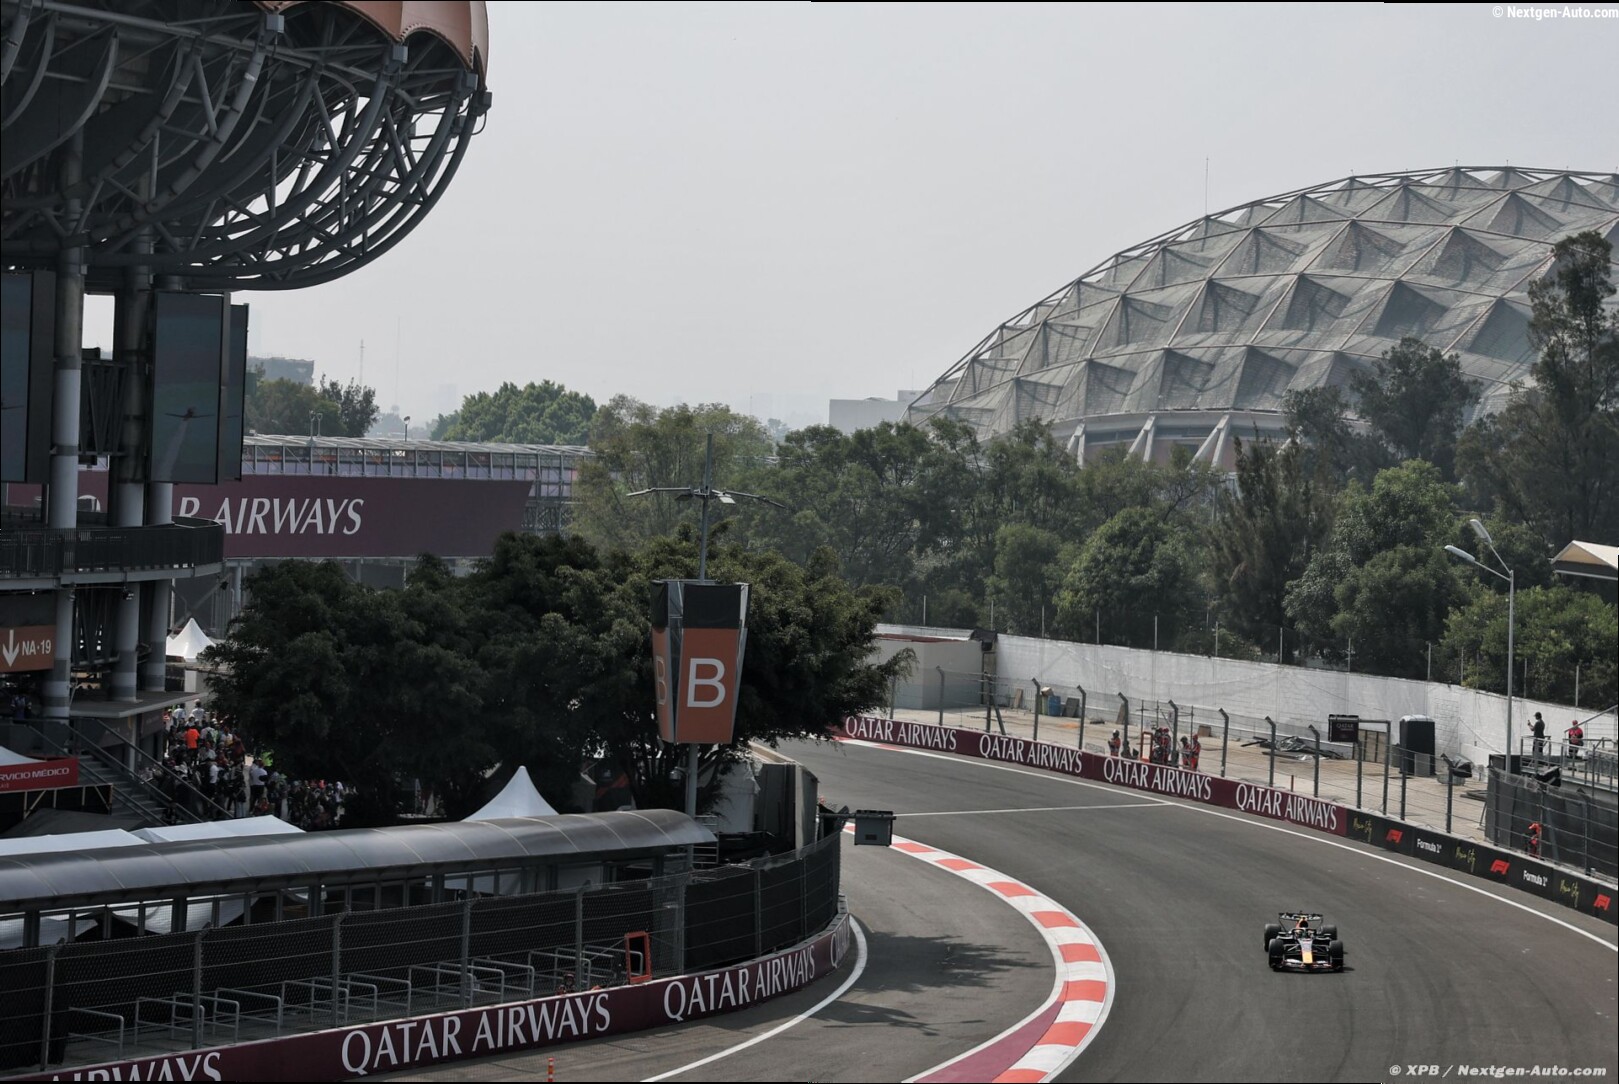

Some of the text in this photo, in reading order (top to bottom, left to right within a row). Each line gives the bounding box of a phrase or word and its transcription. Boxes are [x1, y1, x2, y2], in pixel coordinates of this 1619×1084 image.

[213, 496, 364, 535] AIRWAYS
[687, 657, 726, 708] B
[845, 716, 957, 750] QATAR AIRWAYS
[979, 734, 1082, 774] QATAR AIRWAYS
[1103, 757, 1212, 800] QATAR AIRWAYS
[1235, 783, 1282, 816] QATAR
[1284, 794, 1337, 830] AIRWAYS
[663, 945, 815, 1022] QATAR AIRWAYS
[341, 993, 611, 1076] QATAR AIRWAYS
